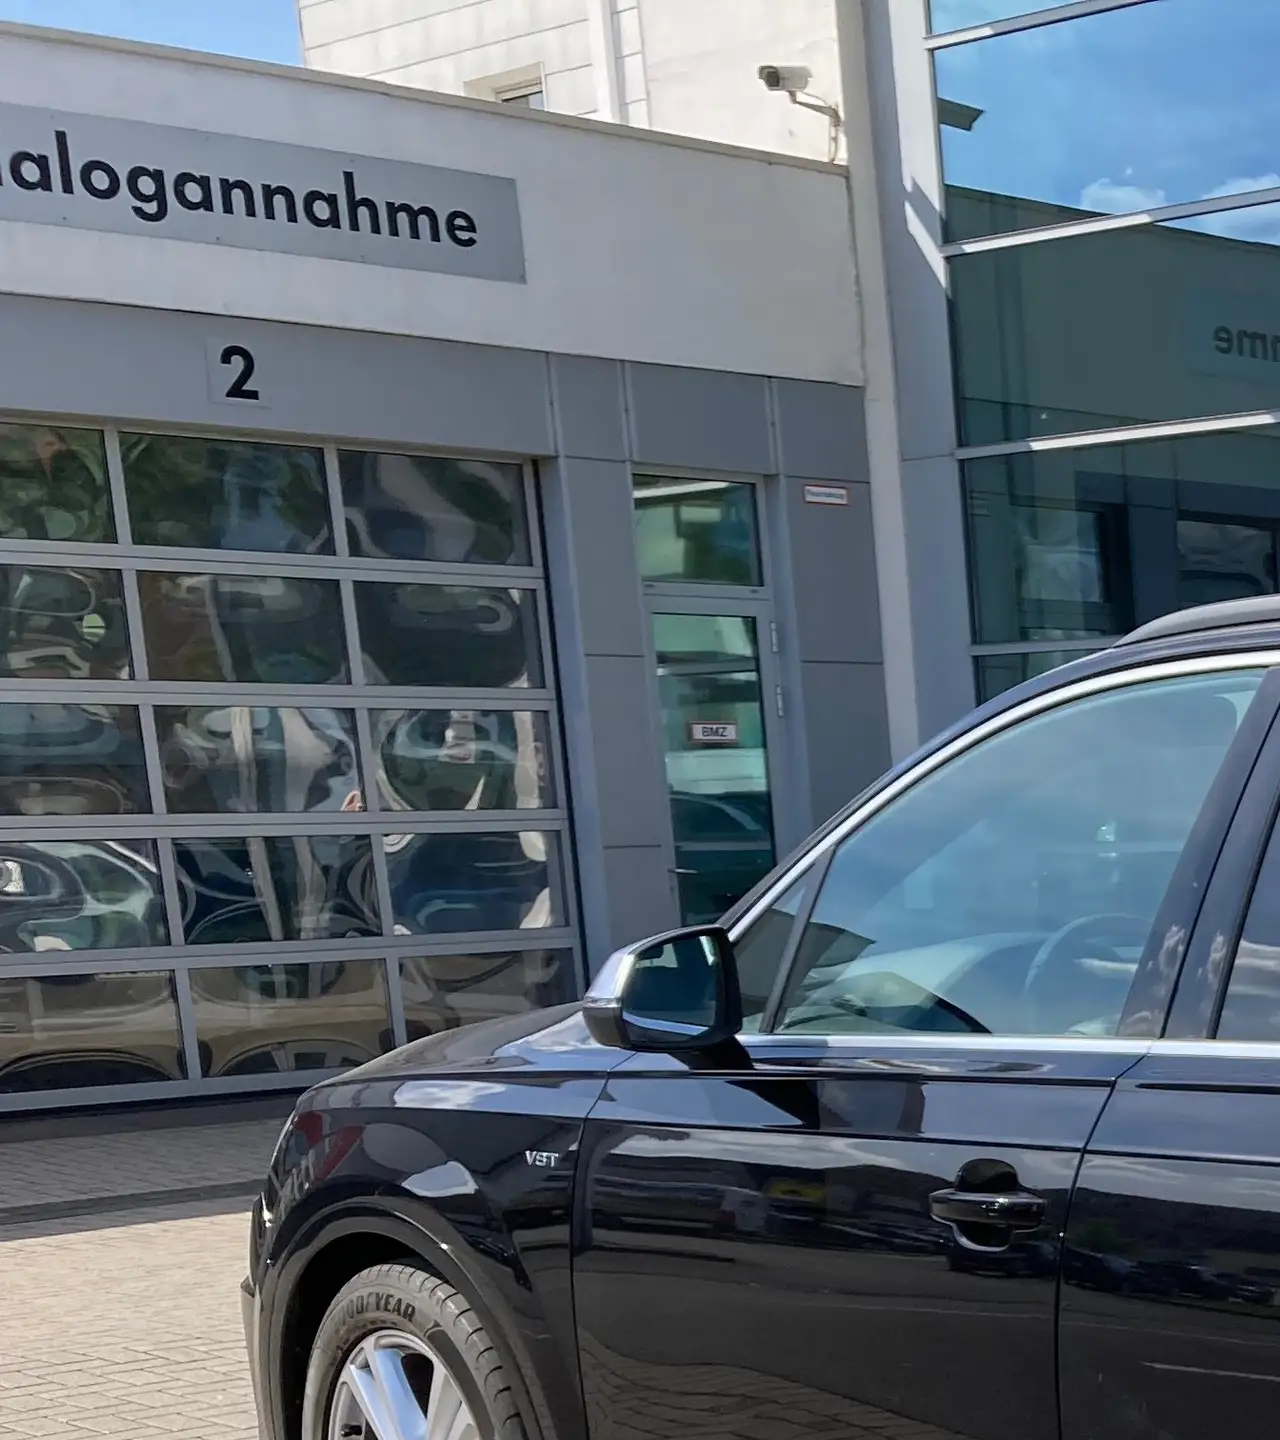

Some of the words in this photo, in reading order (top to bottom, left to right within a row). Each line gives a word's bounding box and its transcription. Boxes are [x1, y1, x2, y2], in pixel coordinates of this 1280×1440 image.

[0, 130, 478, 248] alogannahme
[220, 345, 259, 401] 2
[701, 726, 729, 738] BMZ
